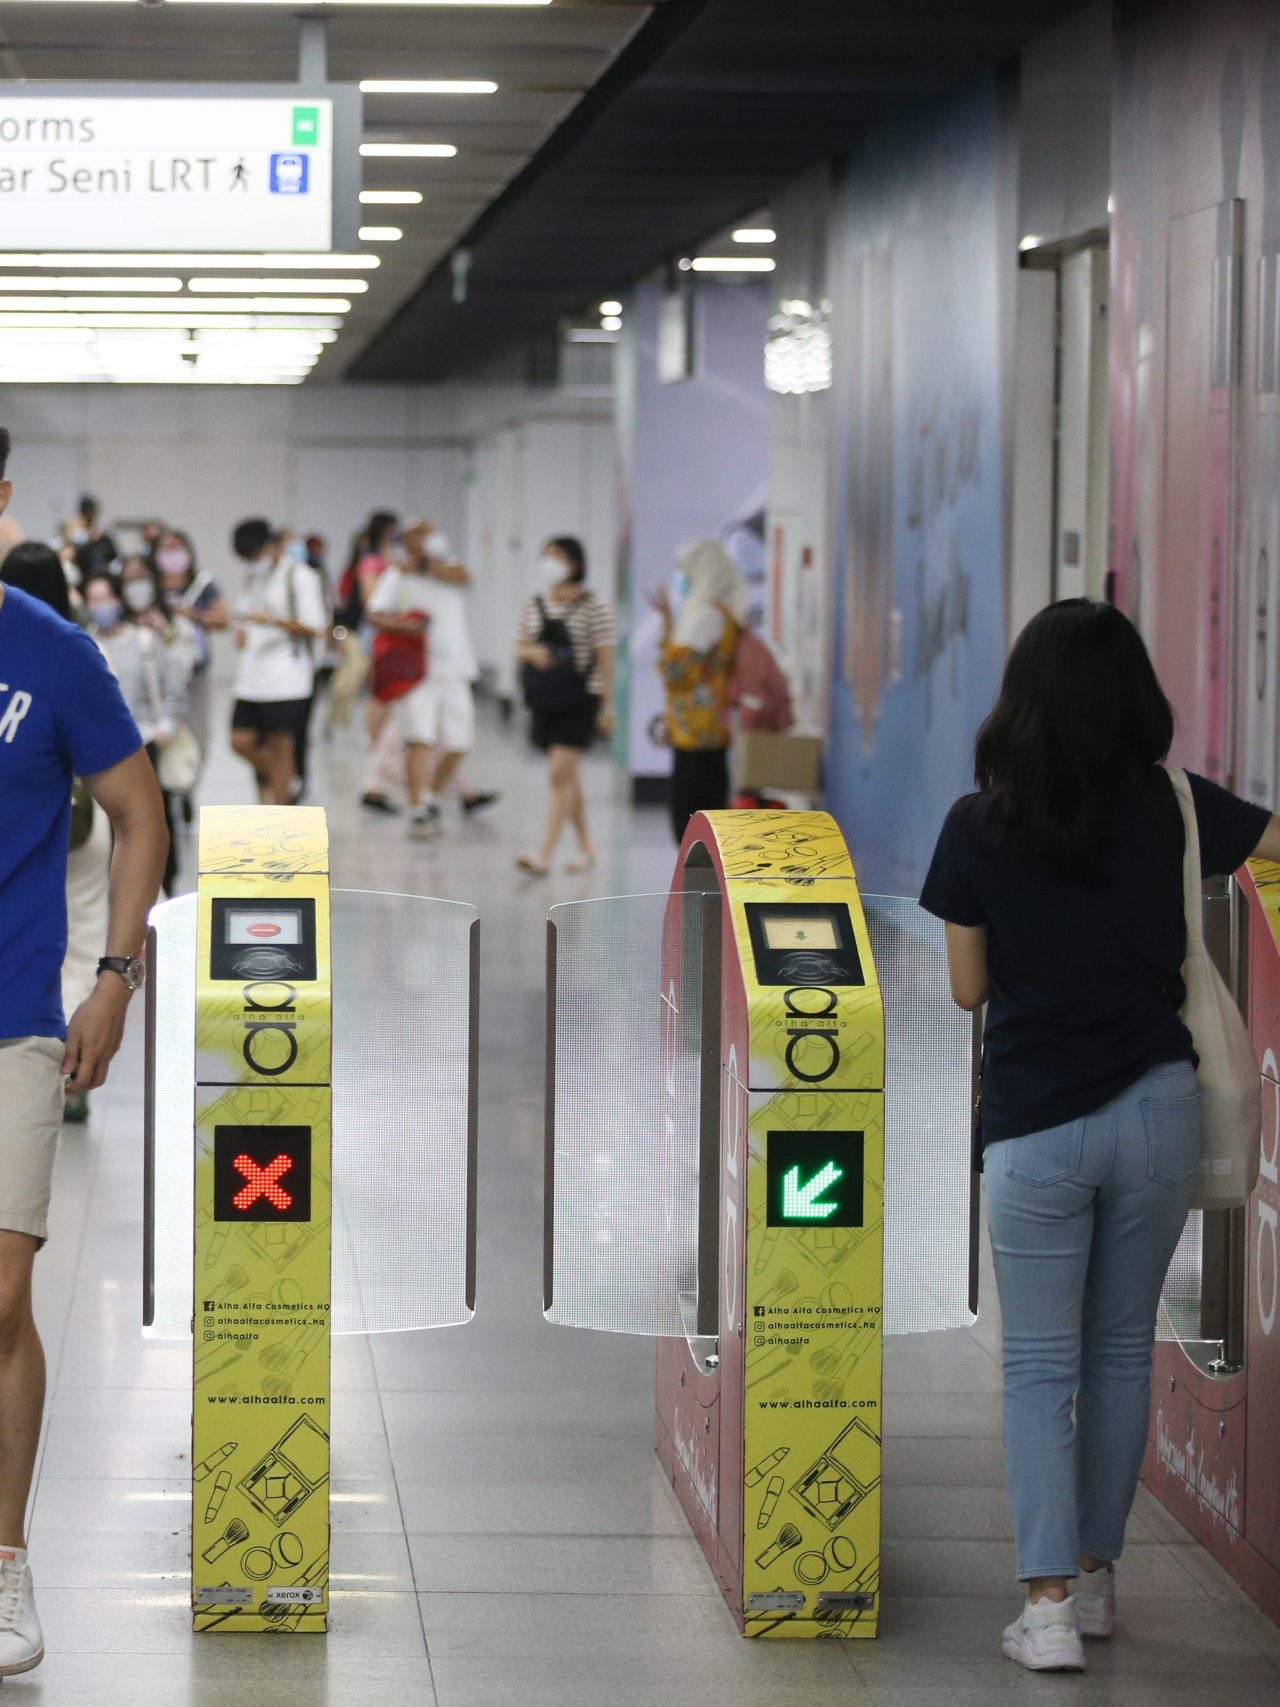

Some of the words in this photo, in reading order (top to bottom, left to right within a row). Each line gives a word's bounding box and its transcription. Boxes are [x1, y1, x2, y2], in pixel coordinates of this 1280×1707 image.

[48, 158, 131, 193] Seni
[149, 158, 217, 192] LRT
[793, 1306, 812, 1314] Alfa
[816, 1306, 864, 1314] Cosmetics
[867, 1306, 881, 1314] HQ
[768, 1337, 810, 1345] alhaalfa
[208, 1395, 326, 1405] www.alhaalfa.com
[759, 1399, 877, 1409] www.alhaalfa.com
[275, 1591, 300, 1599] xerox
